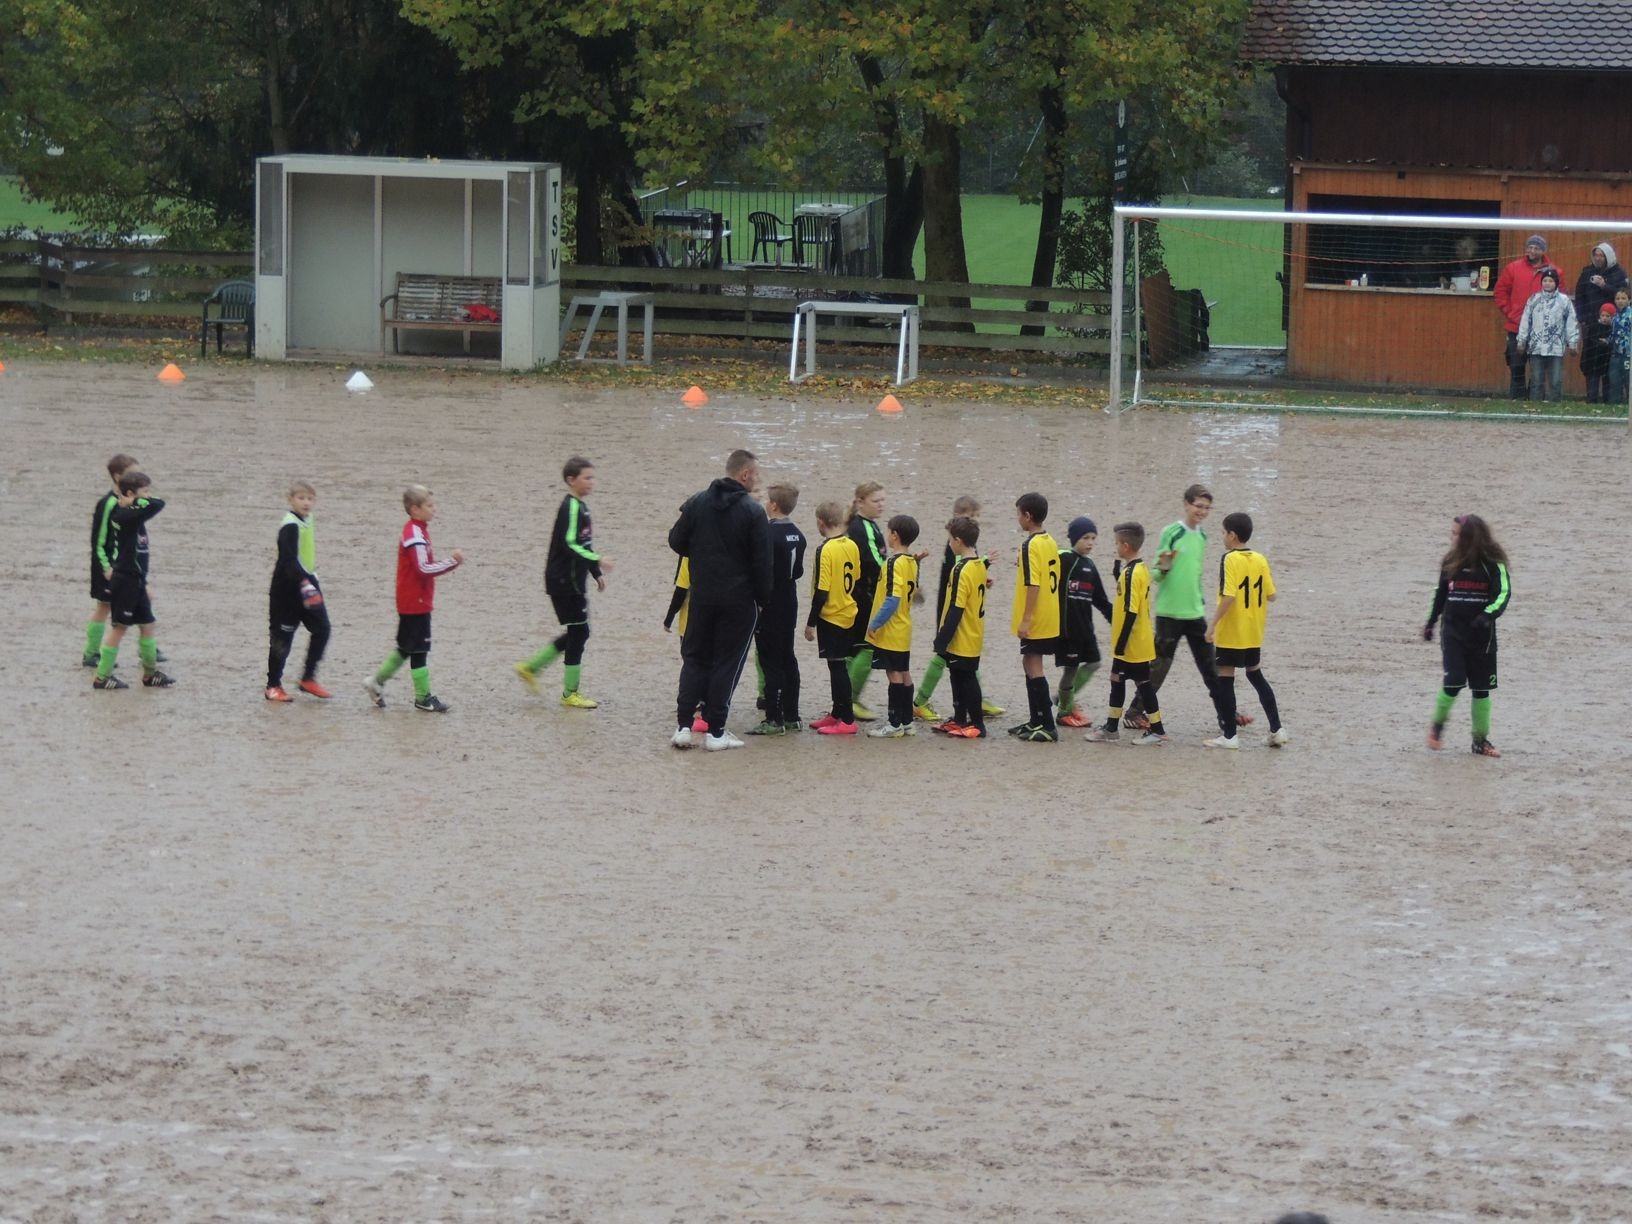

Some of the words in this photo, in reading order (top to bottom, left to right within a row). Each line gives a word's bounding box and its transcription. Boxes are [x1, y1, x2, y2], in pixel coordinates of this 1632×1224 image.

[790, 546, 797, 579] 1
[843, 561, 854, 595] 6
[1048, 559, 1058, 594] 5
[977, 583, 986, 619] 2
[1238, 574, 1264, 609] 11
[1489, 674, 1497, 685] 2
